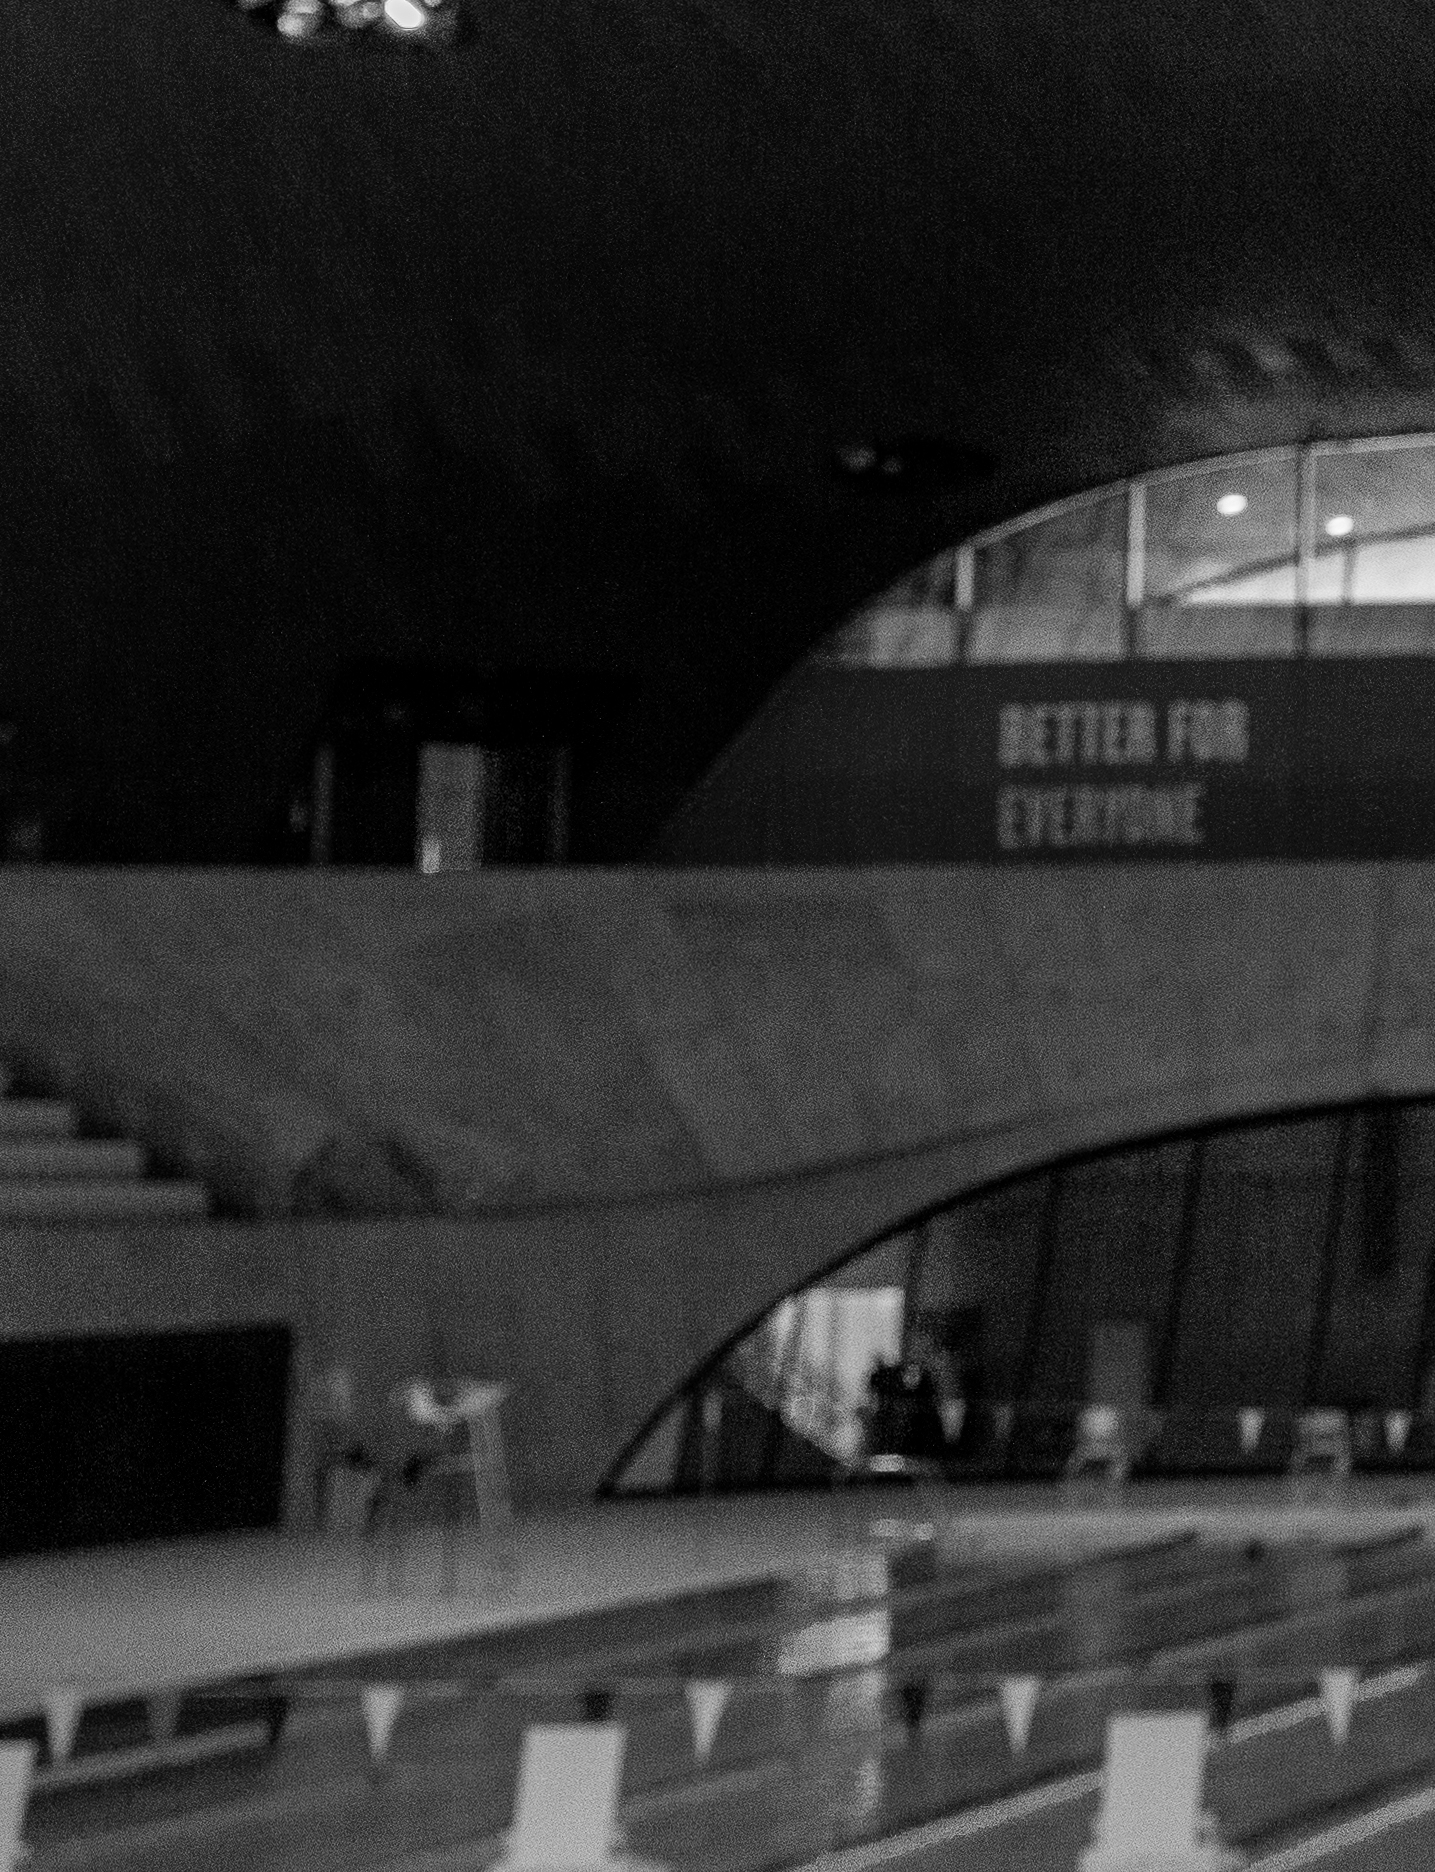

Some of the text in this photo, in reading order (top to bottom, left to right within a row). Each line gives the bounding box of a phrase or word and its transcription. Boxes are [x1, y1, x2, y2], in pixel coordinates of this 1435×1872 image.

[998, 698, 1249, 766] BETTER FOR
[998, 784, 1202, 848] EVERYONE
